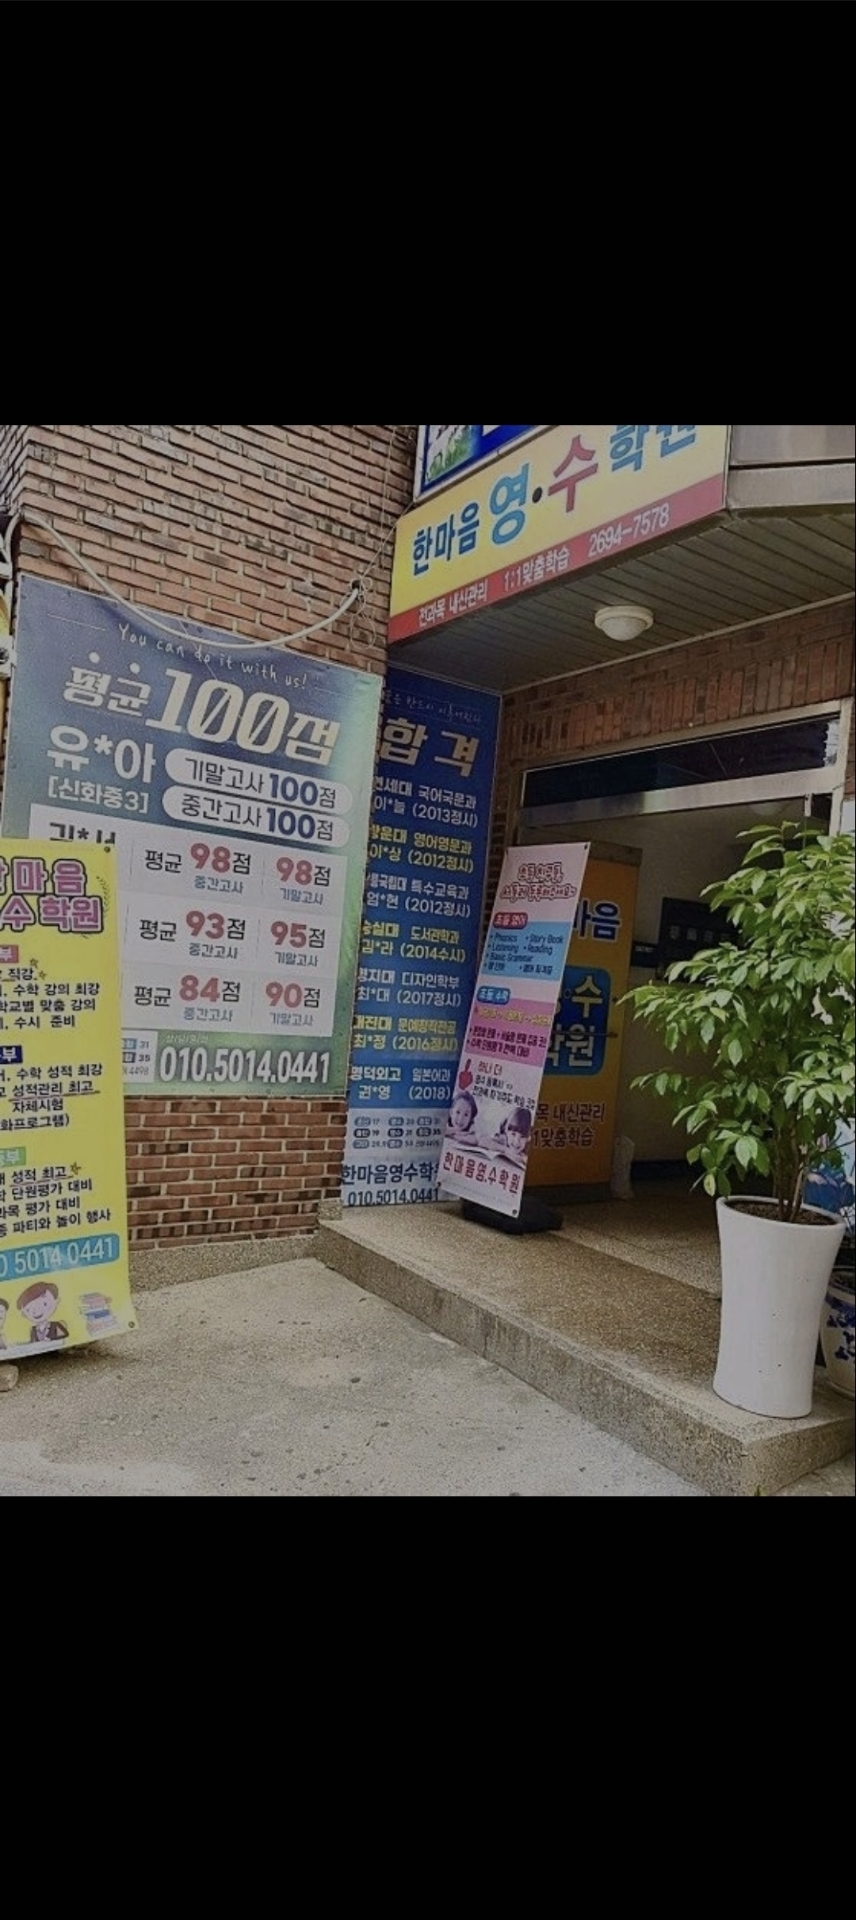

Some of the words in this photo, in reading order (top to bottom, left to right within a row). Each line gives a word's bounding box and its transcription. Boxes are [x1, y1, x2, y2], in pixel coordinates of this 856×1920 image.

[413, 501, 480, 576] 한마음
[418, 597, 446, 628] 전과목
[449, 579, 488, 615] 내신관리
[504, 546, 570, 592] 1:1맞춤학습
[587, 502, 670, 559] 2694-7578
[118, 623, 148, 648] You
[156, 637, 186, 656] can
[191, 646, 212, 664] do
[219, 652, 234, 670] it
[240, 659, 279, 682] with
[285, 669, 308, 690] us!
[63, 664, 152, 718] 평균
[184, 755, 265, 795] 기말고사
[269, 772, 338, 808] 100점
[49, 775, 149, 814] [신화중3]
[418, 784, 477, 810] 국어국문과
[181, 793, 263, 829] 중간고사
[266, 810, 335, 840] 100점
[412, 802, 479, 828] (2013정시)
[413, 832, 473, 855] 영어영문과
[144, 849, 183, 874] 평균
[190, 842, 252, 875] 98점
[276, 857, 332, 887] 98점
[407, 849, 475, 873] (2012정시)
[0, 856, 88, 897] 마음
[193, 875, 244, 894] 중간고사
[279, 888, 325, 906] 기말고사
[411, 879, 469, 900] 특수교육과
[0, 894, 104, 934] 수학원
[405, 896, 471, 918] (2012정시)
[139, 919, 177, 942] 평균
[186, 910, 247, 941] 93점
[271, 921, 326, 949] 95점
[188, 942, 239, 960] 중간고사
[274, 951, 319, 968] 기말고사
[400, 942, 466, 963] (2014수시)
[13, 983, 39, 997] 수학
[44, 983, 70, 996] 강의
[75, 982, 100, 996] 최강
[134, 985, 172, 1008] 평균
[179, 974, 241, 1003] 84점
[265, 981, 321, 1009] 90점
[401, 971, 460, 989] 디자인학부
[40, 999, 66, 1013] 맞춤
[70, 998, 96, 1011] 강의
[397, 989, 461, 1007] (2017정시)
[14, 1016, 41, 1029] 수시
[50, 1015, 76, 1028] 준비
[183, 1007, 234, 1023] 중간고사
[269, 1011, 314, 1028] 기말고사
[392, 1036, 458, 1051] (2016정시)
[17, 1067, 42, 1080] 수학
[47, 1065, 73, 1079] 성적
[78, 1063, 103, 1076] 최강
[159, 1046, 331, 1084] 010.5014.0441
[412, 1067, 451, 1083] 일본어과
[12, 1082, 63, 1097] 성적관리
[68, 1080, 94, 1092] 최고
[409, 1085, 451, 1101] (2018)
[12, 1098, 64, 1113] 자체시험
[553, 1102, 605, 1123] 내신관리
[12, 1168, 37, 1183] 성적
[42, 1166, 67, 1180] 최고
[341, 1162, 439, 1185] 한마음영수학
[12, 1182, 63, 1201] 단원평가
[68, 1178, 93, 1192] 대비
[347, 1187, 439, 1206] 010.5014.0441
[25, 1201, 51, 1216] 평가
[56, 1196, 81, 1210] 대비
[13, 1217, 51, 1233] 파티와
[56, 1212, 81, 1228] 놀이
[86, 1208, 111, 1224] 행사
[14, 1246, 62, 1274] 5014
[67, 1237, 114, 1264] 0441
